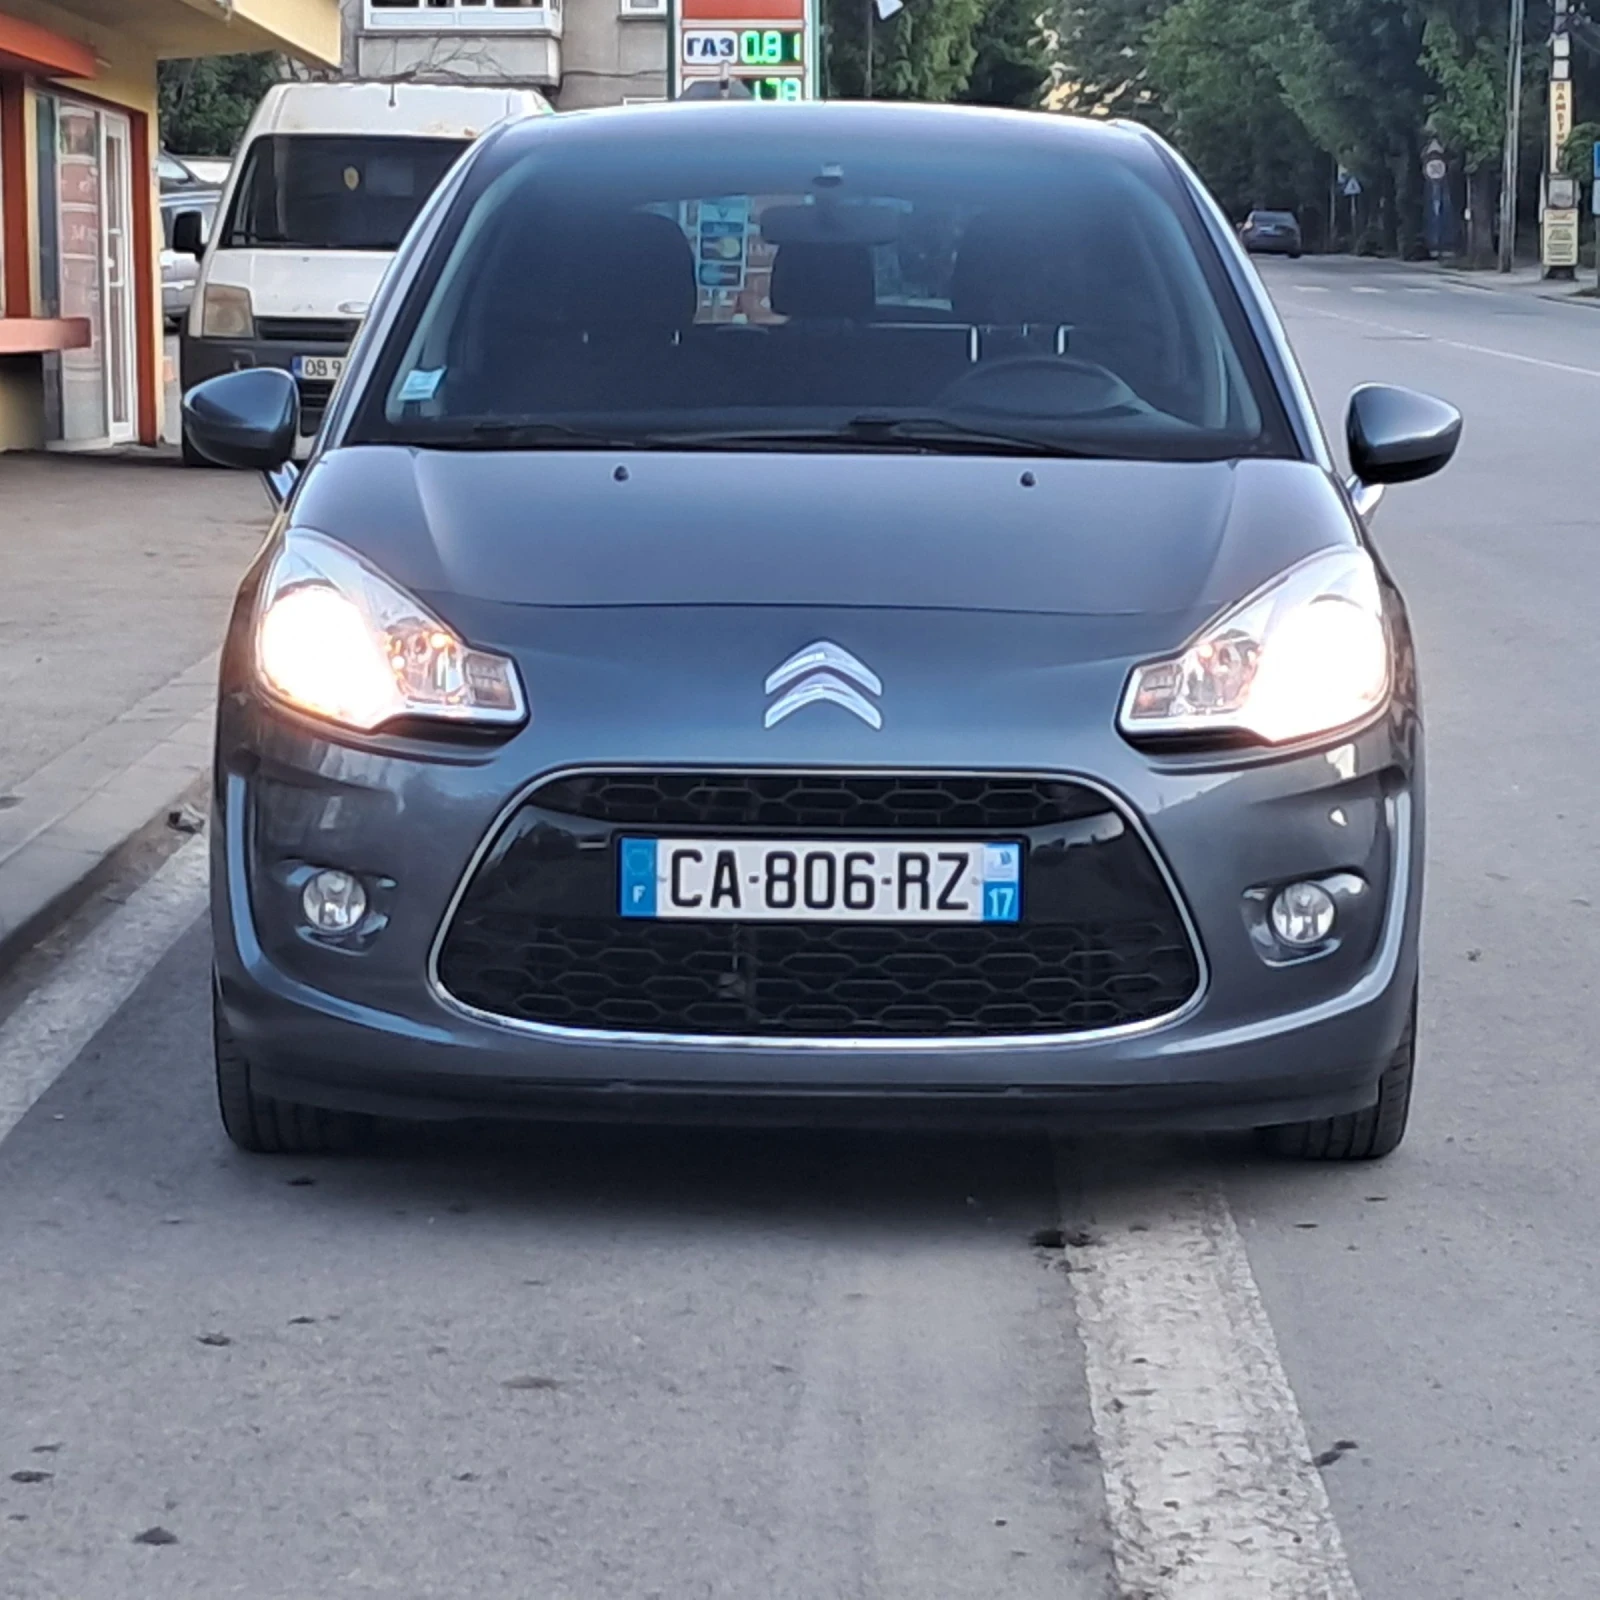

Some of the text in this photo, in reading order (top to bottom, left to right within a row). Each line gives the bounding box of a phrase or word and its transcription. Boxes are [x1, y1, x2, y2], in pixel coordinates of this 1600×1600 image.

[686, 37, 734, 57] ГАЗ
[670, 848, 970, 911] CA-806-RZ
[632, 885, 647, 904] F
[988, 887, 1014, 918] 17
